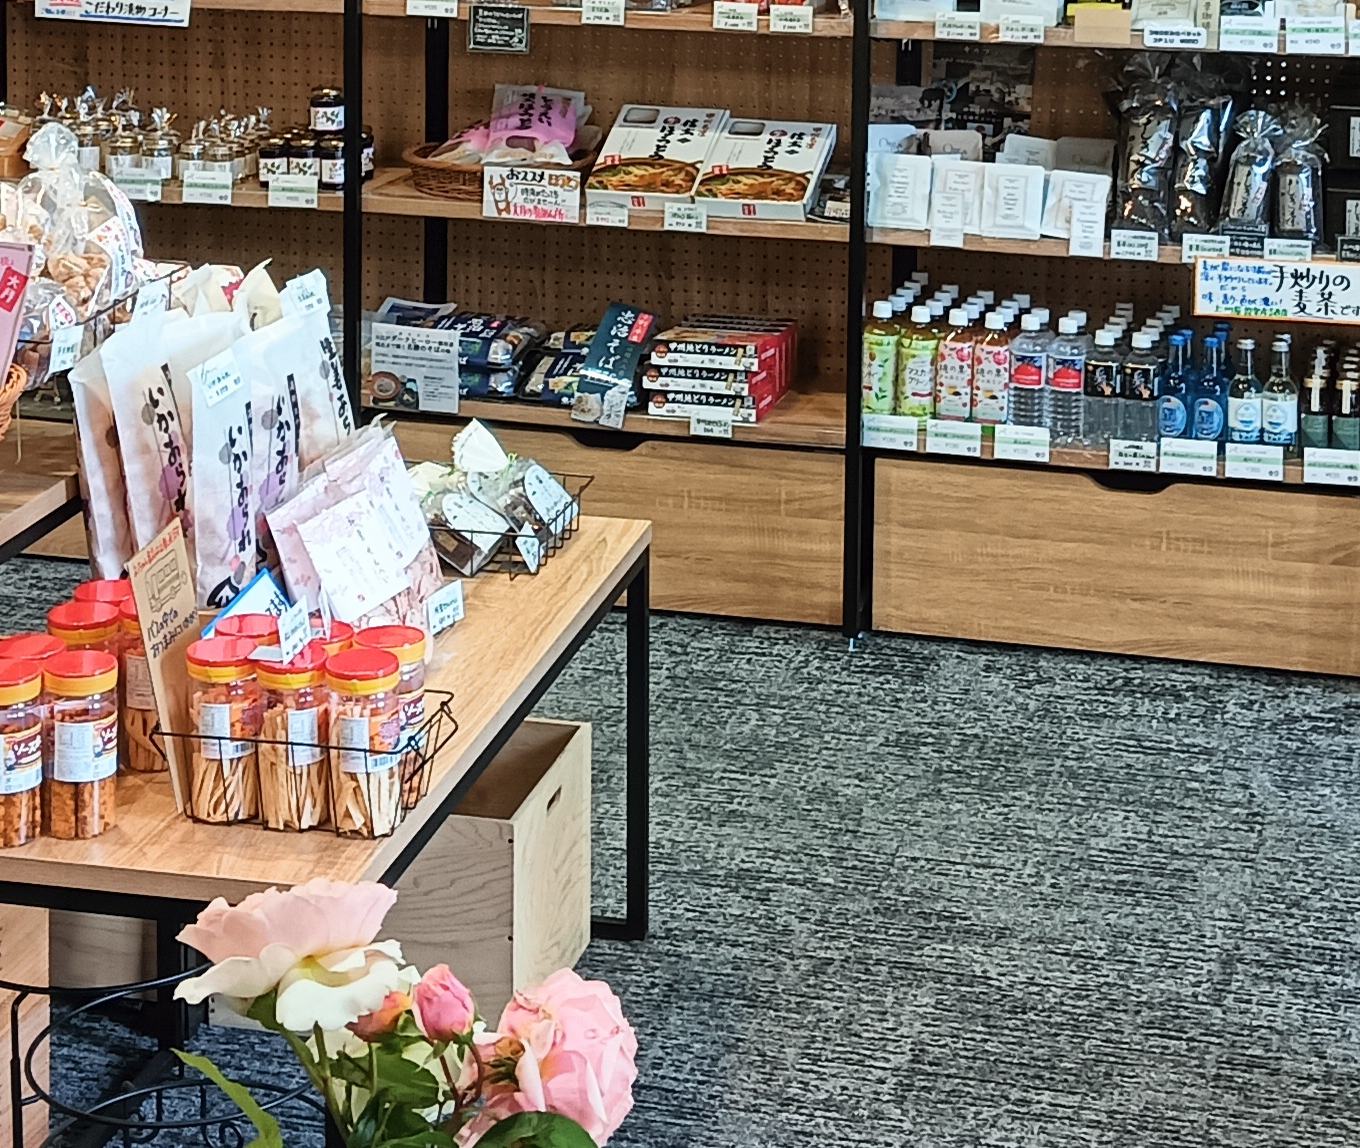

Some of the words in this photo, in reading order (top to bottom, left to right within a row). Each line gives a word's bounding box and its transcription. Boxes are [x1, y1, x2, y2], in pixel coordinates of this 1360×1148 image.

[0, 274, 21, 304] 大月
[1271, 263, 1351, 293] 手炒りの
